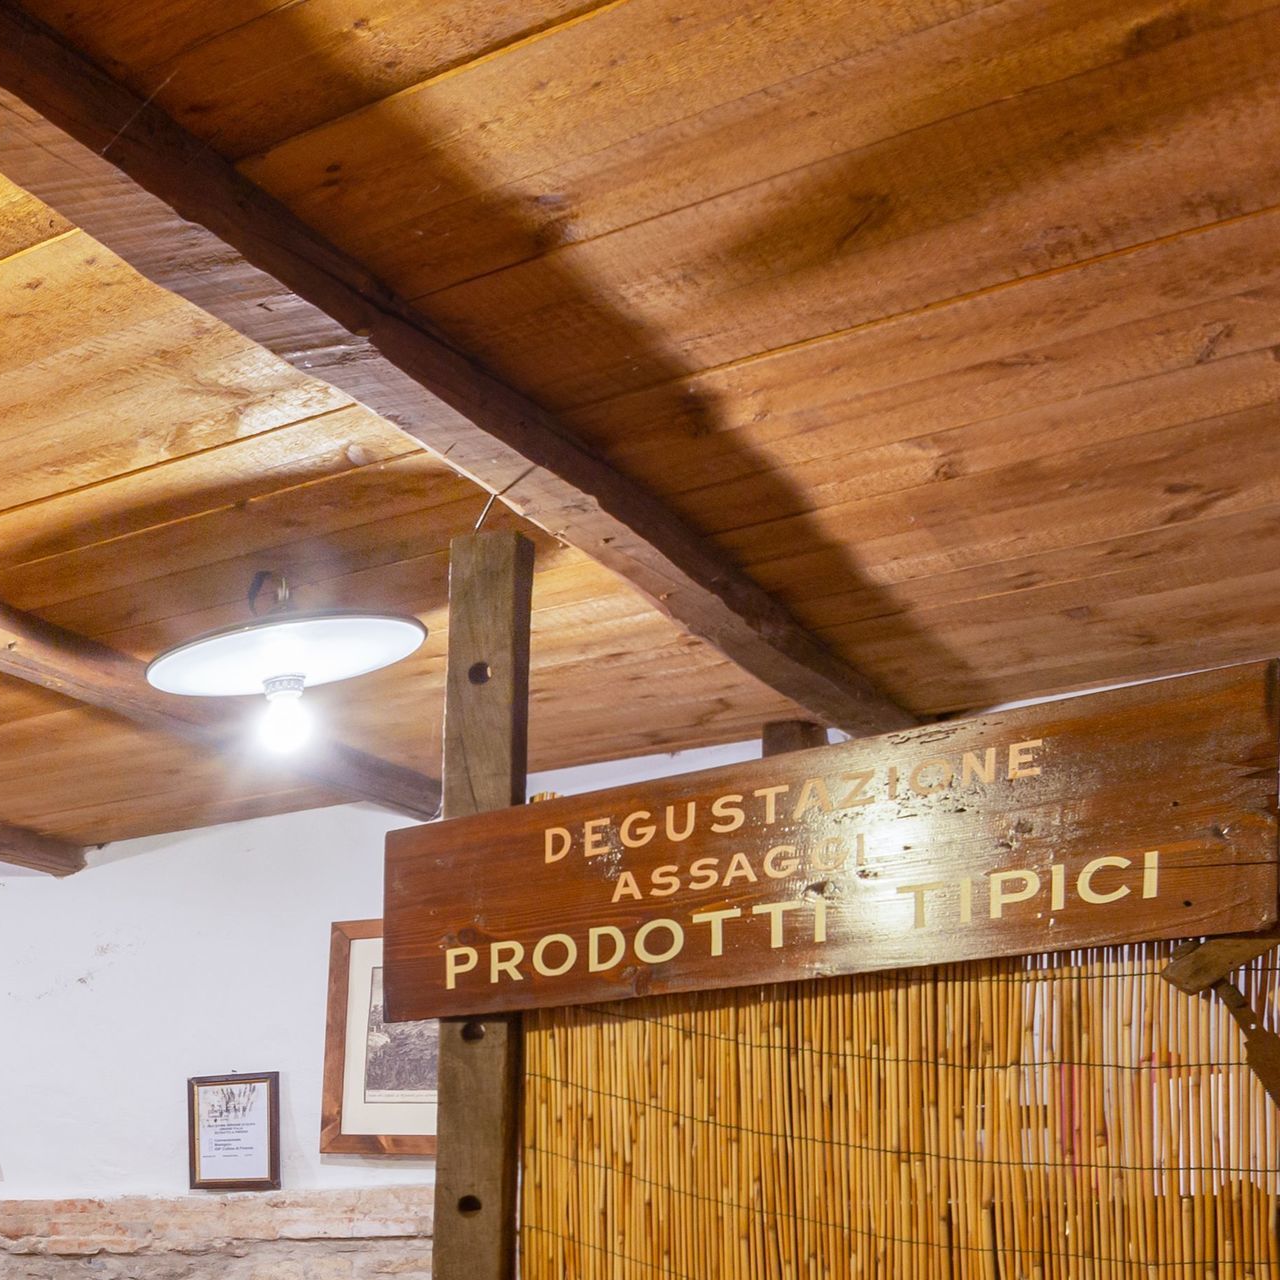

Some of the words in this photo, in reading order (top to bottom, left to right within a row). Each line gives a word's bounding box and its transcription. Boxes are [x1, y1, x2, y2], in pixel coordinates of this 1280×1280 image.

[544, 738, 1043, 865] DEGUSTAZIONE
[444, 898, 828, 990] PRODOTTI
[896, 850, 1160, 930] TIPICI
[611, 832, 867, 903] ASSAGGI
